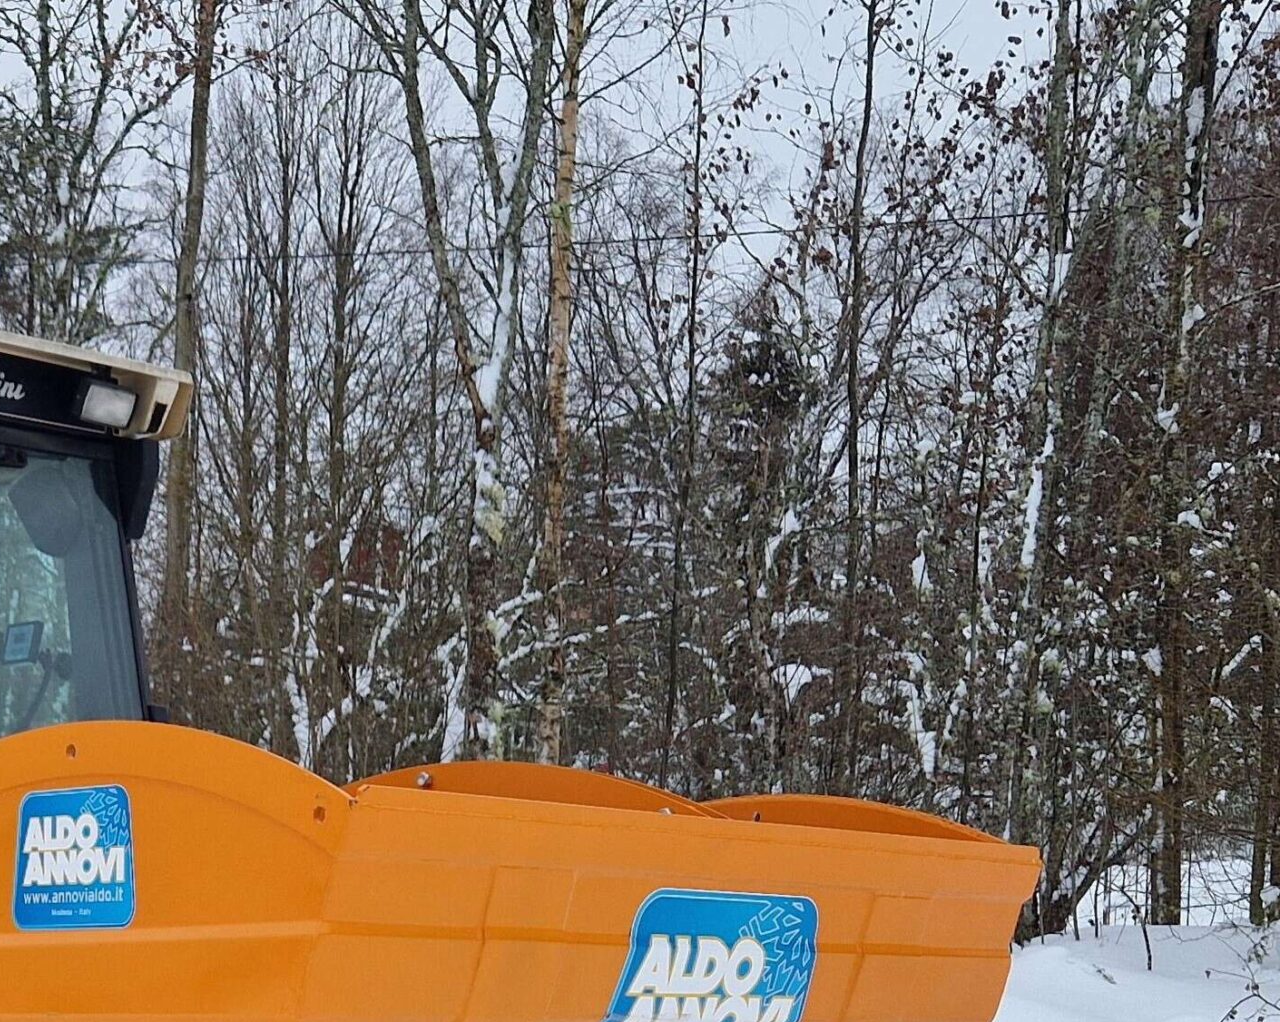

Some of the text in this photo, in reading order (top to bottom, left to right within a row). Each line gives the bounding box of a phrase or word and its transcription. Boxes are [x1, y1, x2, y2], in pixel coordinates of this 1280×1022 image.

[22, 813, 99, 853] ALDO
[22, 845, 126, 886] ANNOVI
[23, 886, 124, 904] www.annovialdo.it
[626, 934, 765, 996] ALDO
